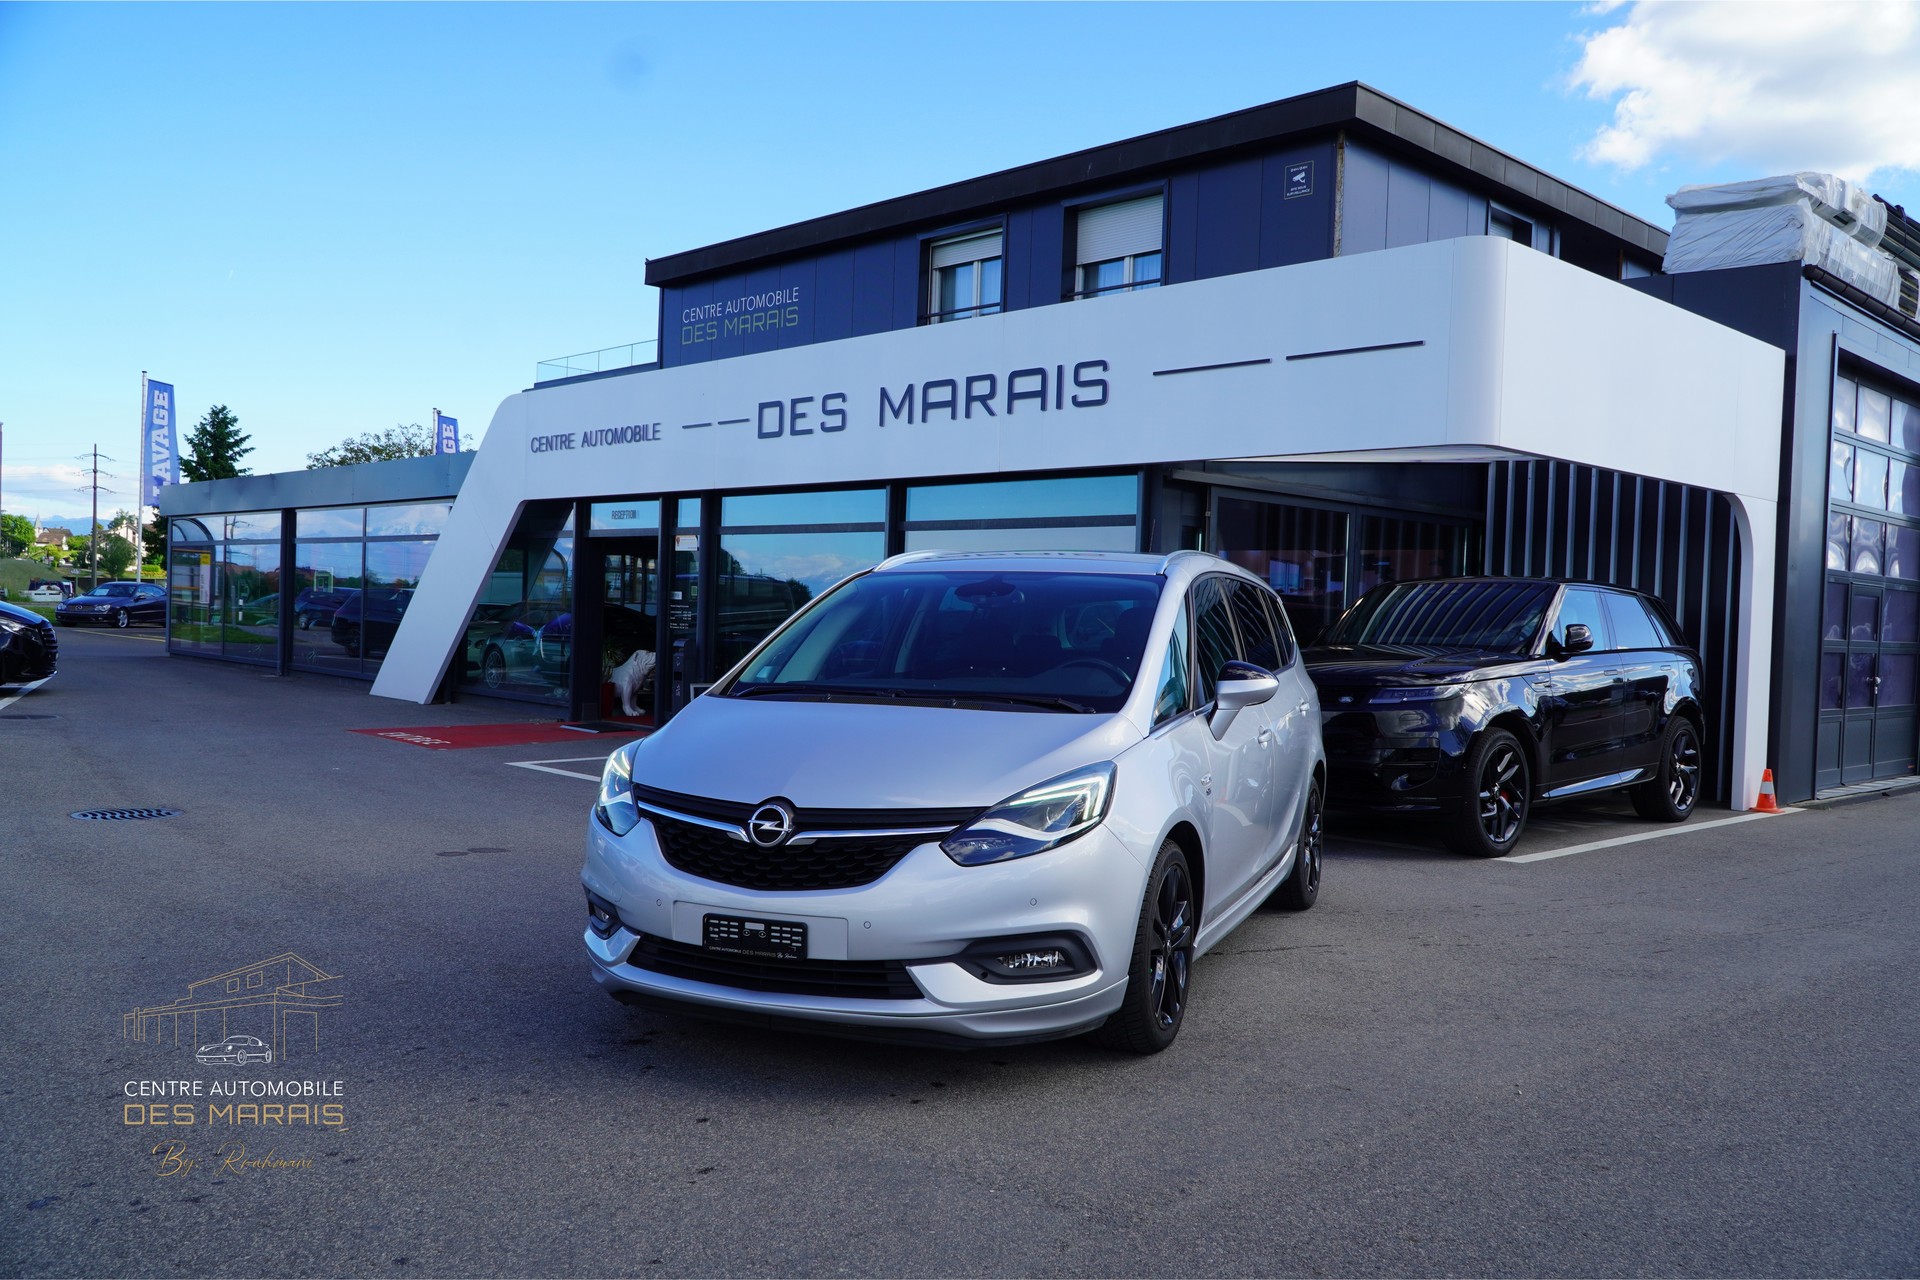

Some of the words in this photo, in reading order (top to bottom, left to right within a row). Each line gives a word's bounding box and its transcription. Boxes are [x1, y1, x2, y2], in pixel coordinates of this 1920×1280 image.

[682, 302, 723, 323] CENTRE
[725, 286, 799, 315] AUTOMOBILE
[682, 321, 718, 345] DES
[724, 306, 799, 338] MARAIS
[757, 391, 847, 439] DES
[879, 359, 1109, 427] MARAIS
[530, 433, 576, 453] CENTRE
[581, 422, 661, 448] AUTOMOBILE
